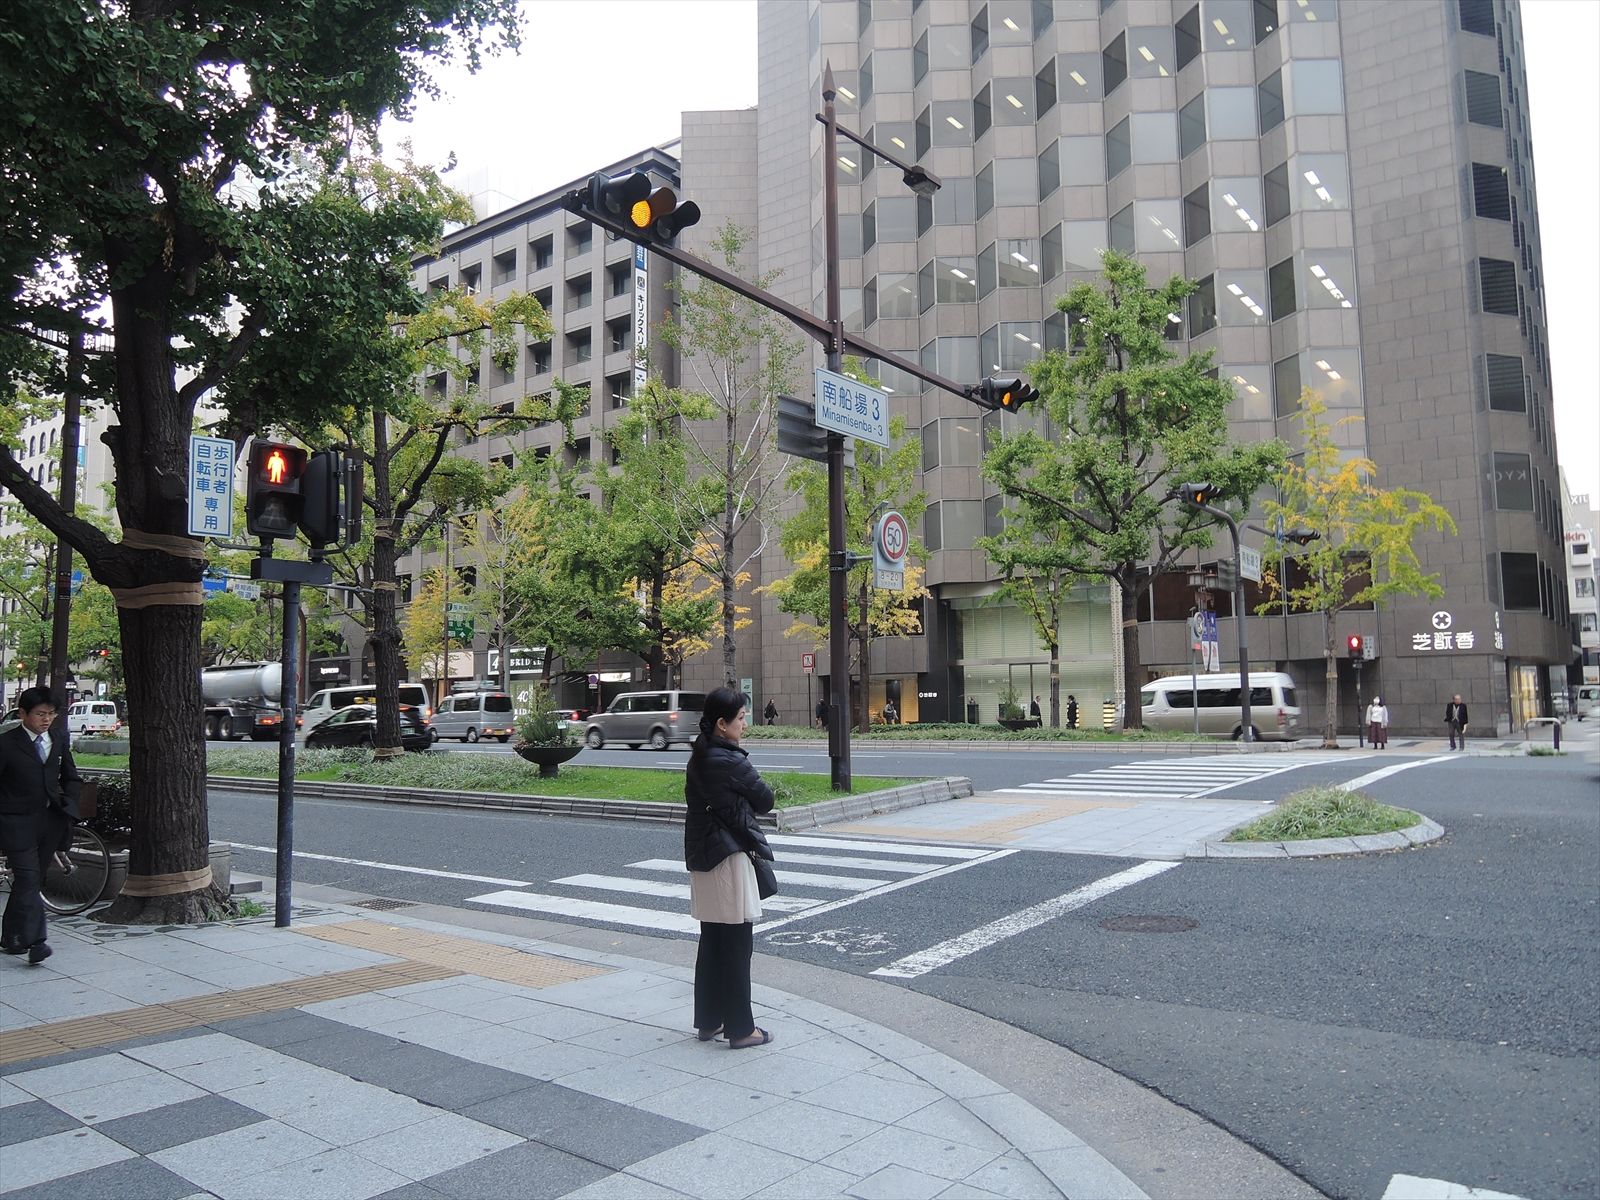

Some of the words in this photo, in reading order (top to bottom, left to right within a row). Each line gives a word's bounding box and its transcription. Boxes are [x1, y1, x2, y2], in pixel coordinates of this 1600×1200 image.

[196, 444, 211, 493] 自転車
[213, 446, 229, 494] 歩行者
[204, 496, 218, 530] 専用
[887, 526, 901, 548] 50
